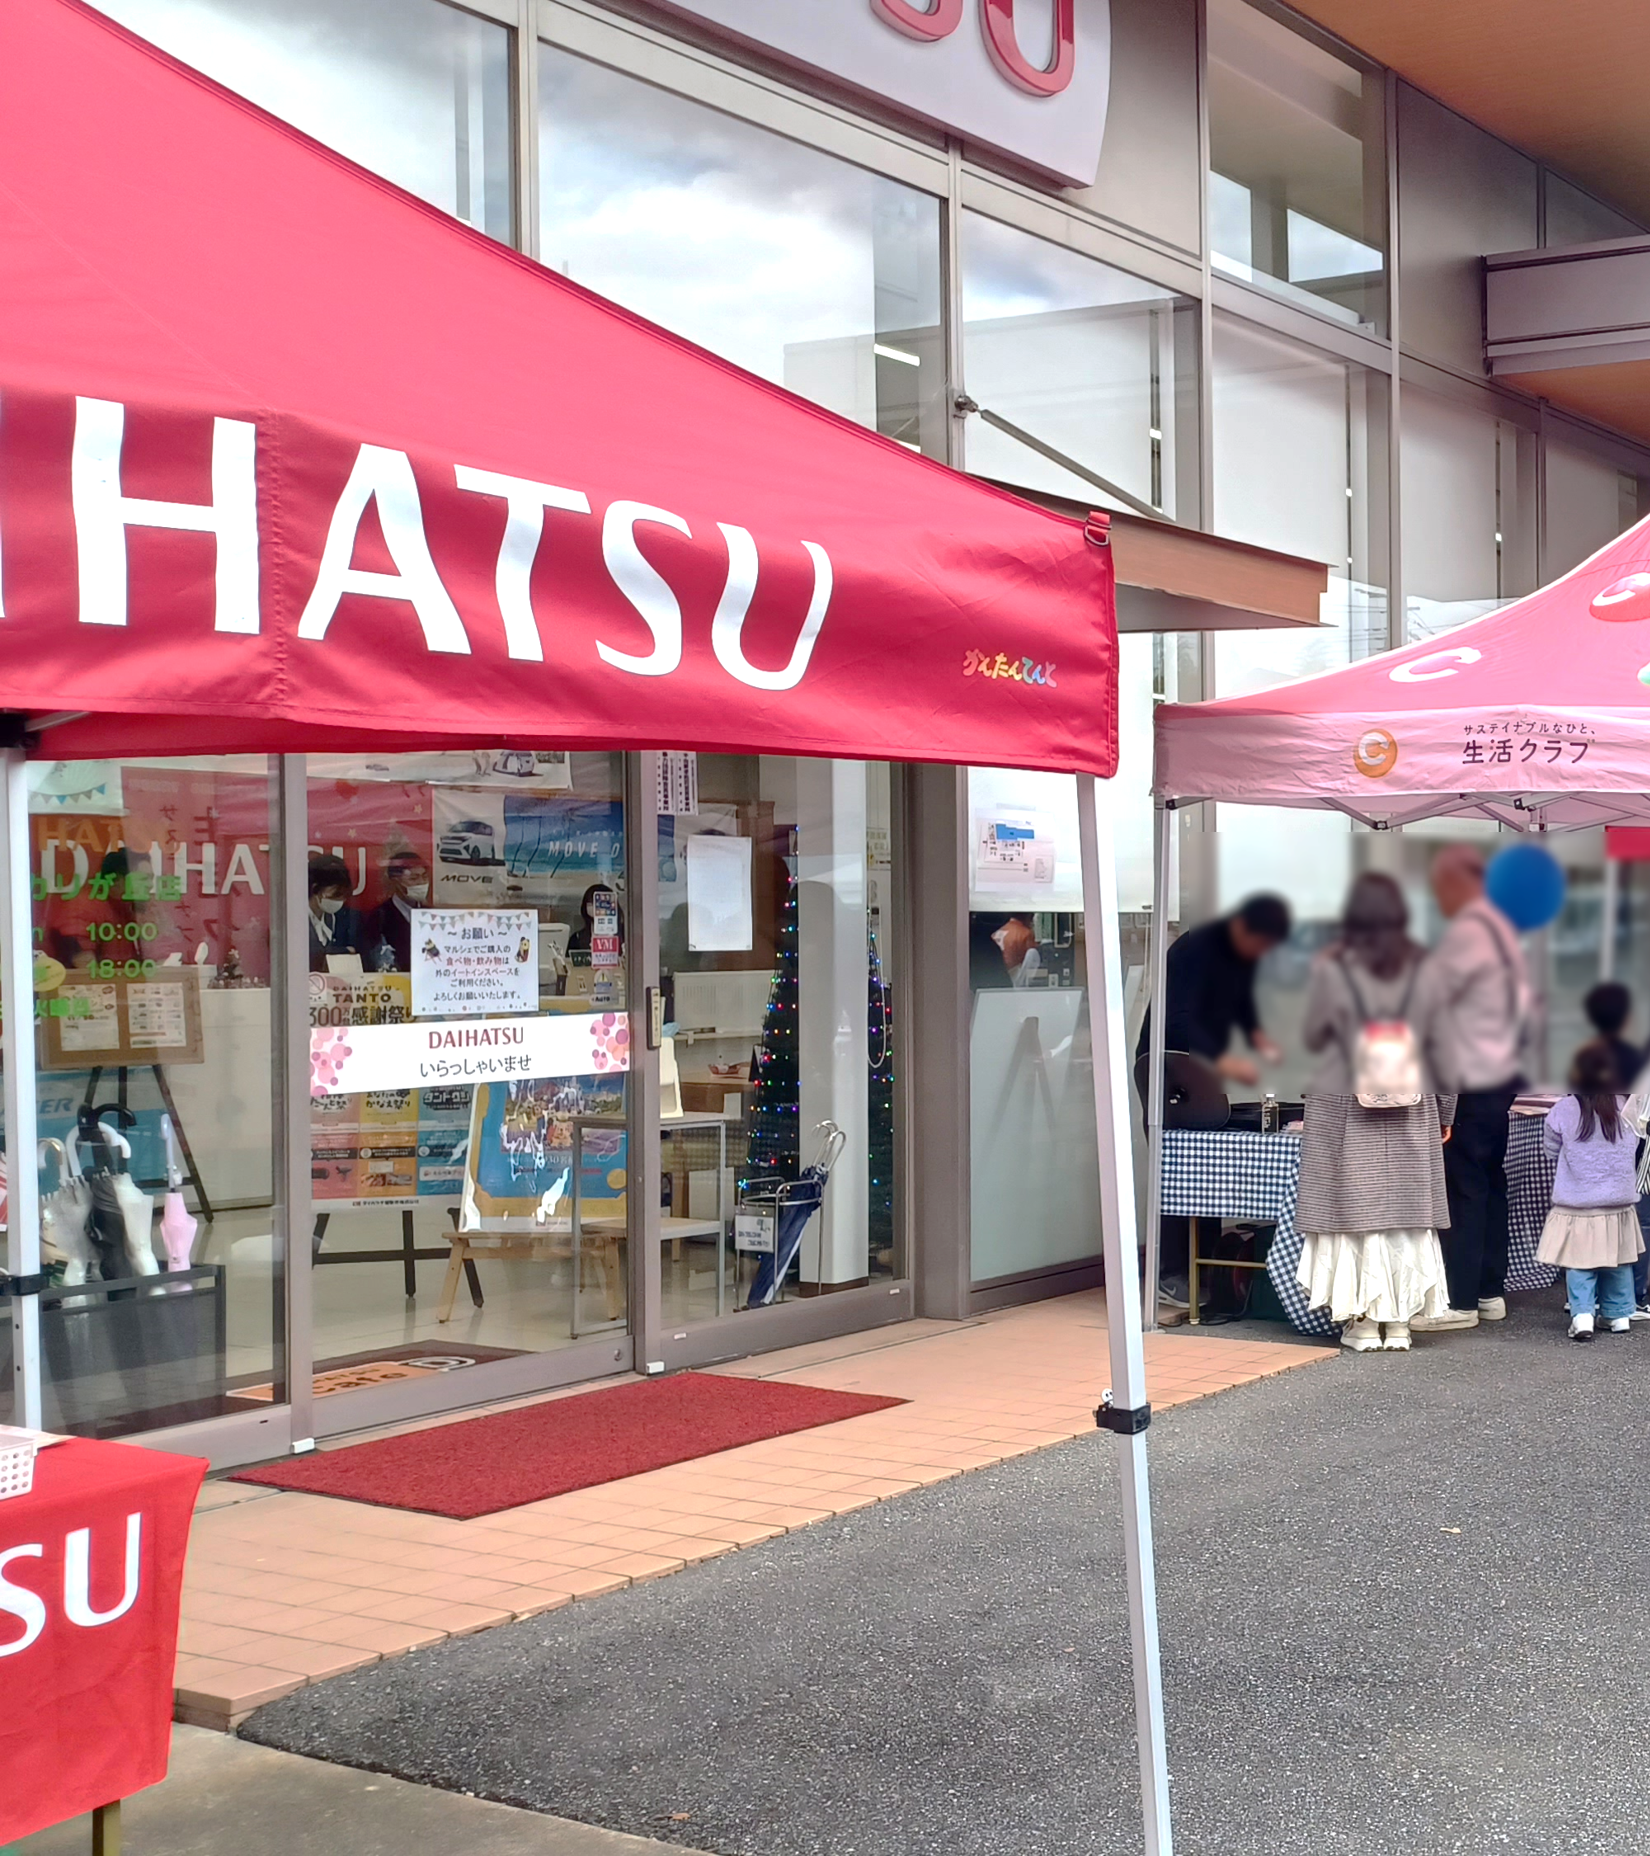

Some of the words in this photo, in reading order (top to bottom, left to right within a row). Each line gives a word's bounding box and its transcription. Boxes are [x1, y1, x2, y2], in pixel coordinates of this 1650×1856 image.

[0, 396, 833, 690] HATSU
[962, 648, 1058, 688] かんたんてんと
[548, 841, 598, 858] MOVE
[440, 874, 494, 884] MOVE
[86, 922, 158, 941] 10:00
[87, 959, 157, 979] 18:00
[333, 993, 391, 1003] TANTO
[429, 1027, 524, 1049] DAIHATSU
[420, 1055, 532, 1077] いらっしゃいませ
